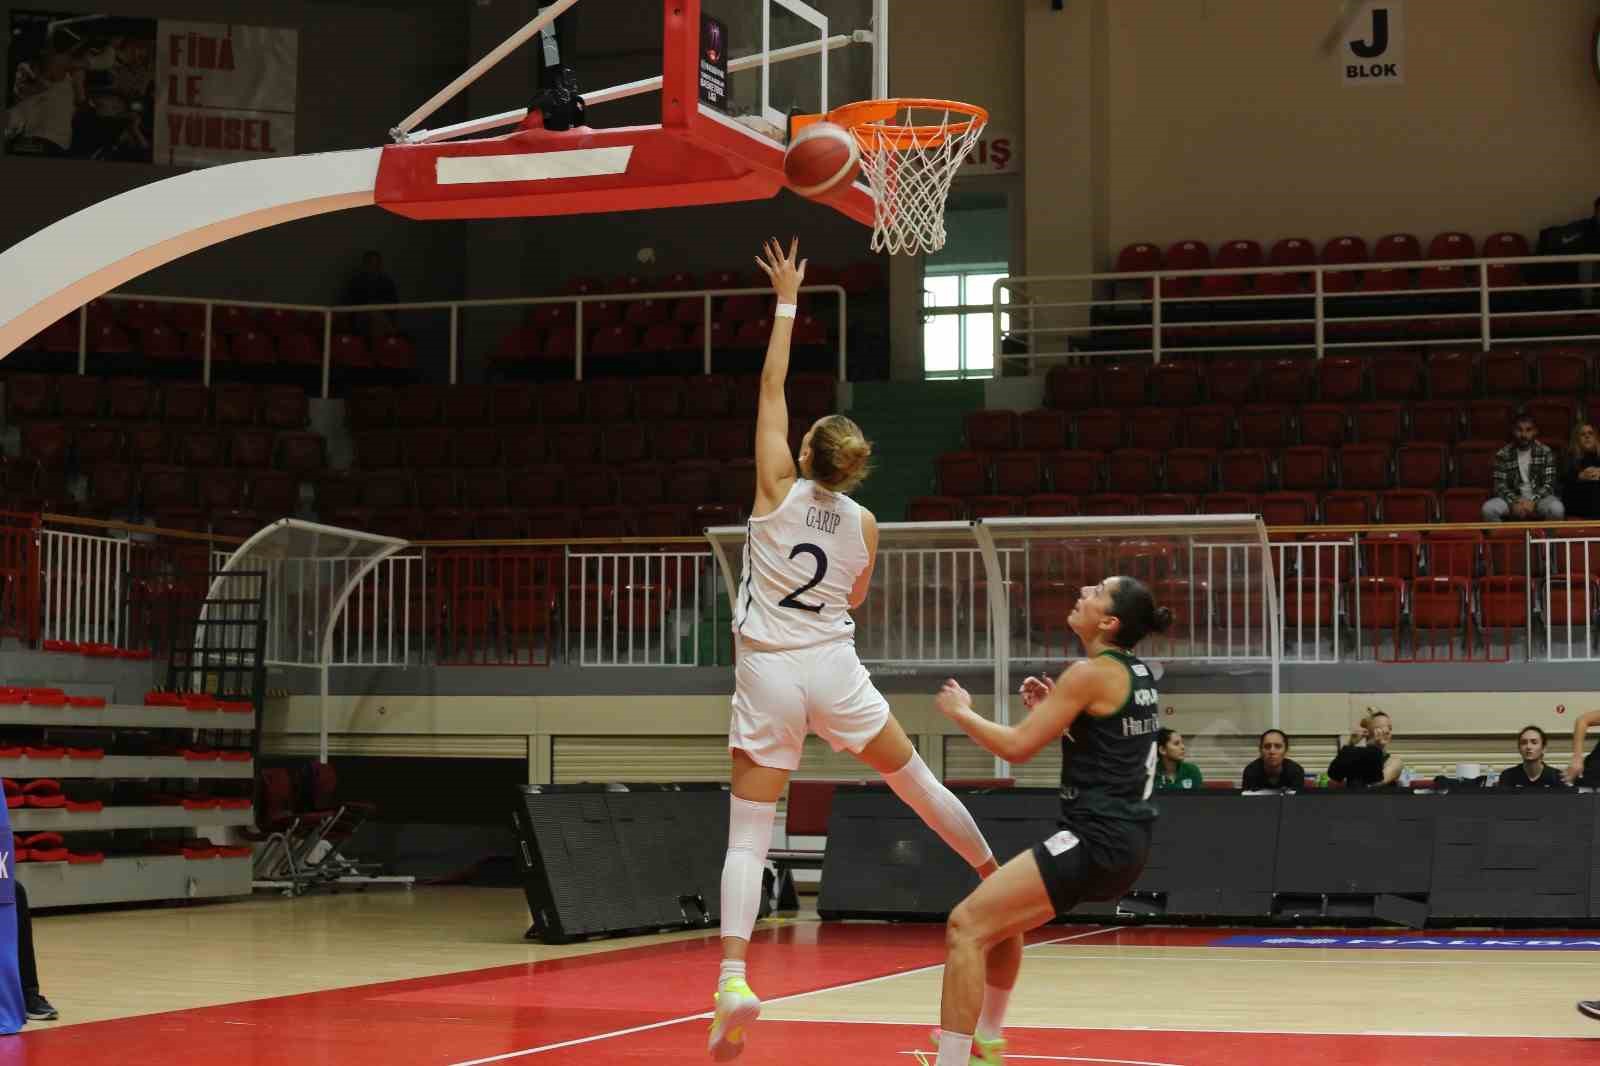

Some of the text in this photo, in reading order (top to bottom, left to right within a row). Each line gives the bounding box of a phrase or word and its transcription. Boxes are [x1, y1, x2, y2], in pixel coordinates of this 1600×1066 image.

[1349, 9, 1388, 57] J
[1346, 63, 1397, 78] BLOK
[778, 543, 828, 614] 2
